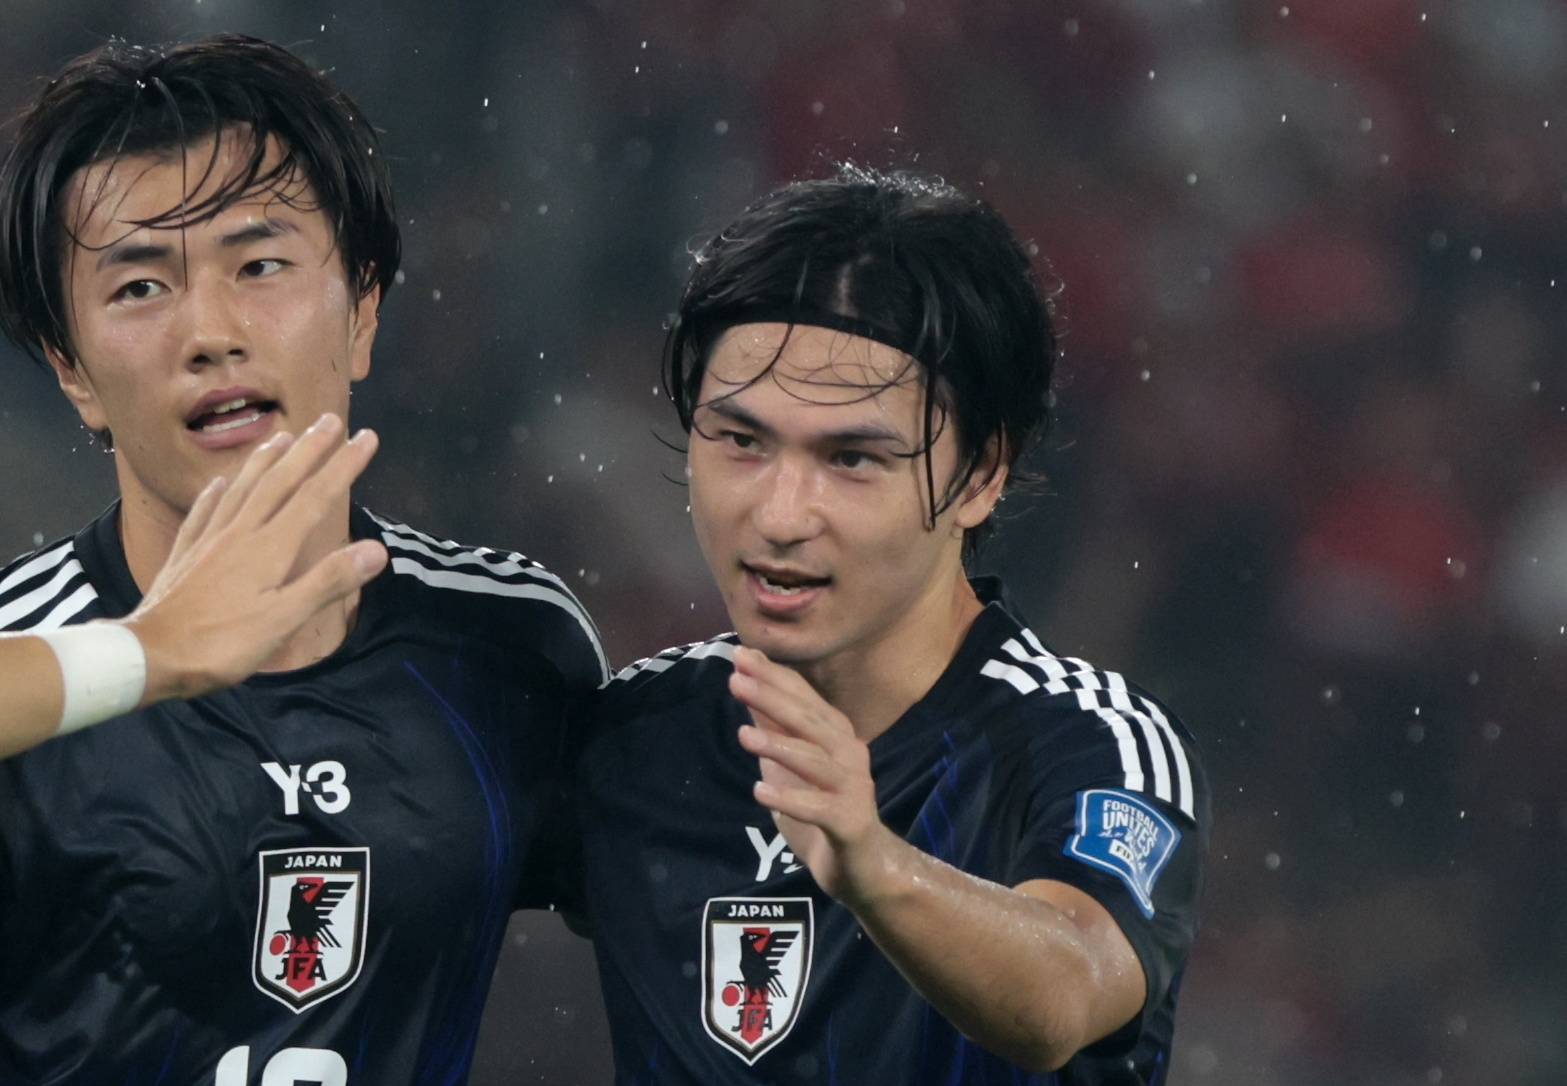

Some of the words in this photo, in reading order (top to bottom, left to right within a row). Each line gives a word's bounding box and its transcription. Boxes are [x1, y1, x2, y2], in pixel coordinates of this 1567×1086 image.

[259, 760, 351, 815] Y-3
[1103, 799, 1159, 842] FOOTBALL
[1103, 810, 1155, 857] UNITES
[284, 855, 343, 869] JAPAN
[745, 826, 805, 882] Y-
[728, 904, 785, 918] JAPAN
[275, 957, 327, 981] JFA
[731, 1008, 773, 1032] JFA
